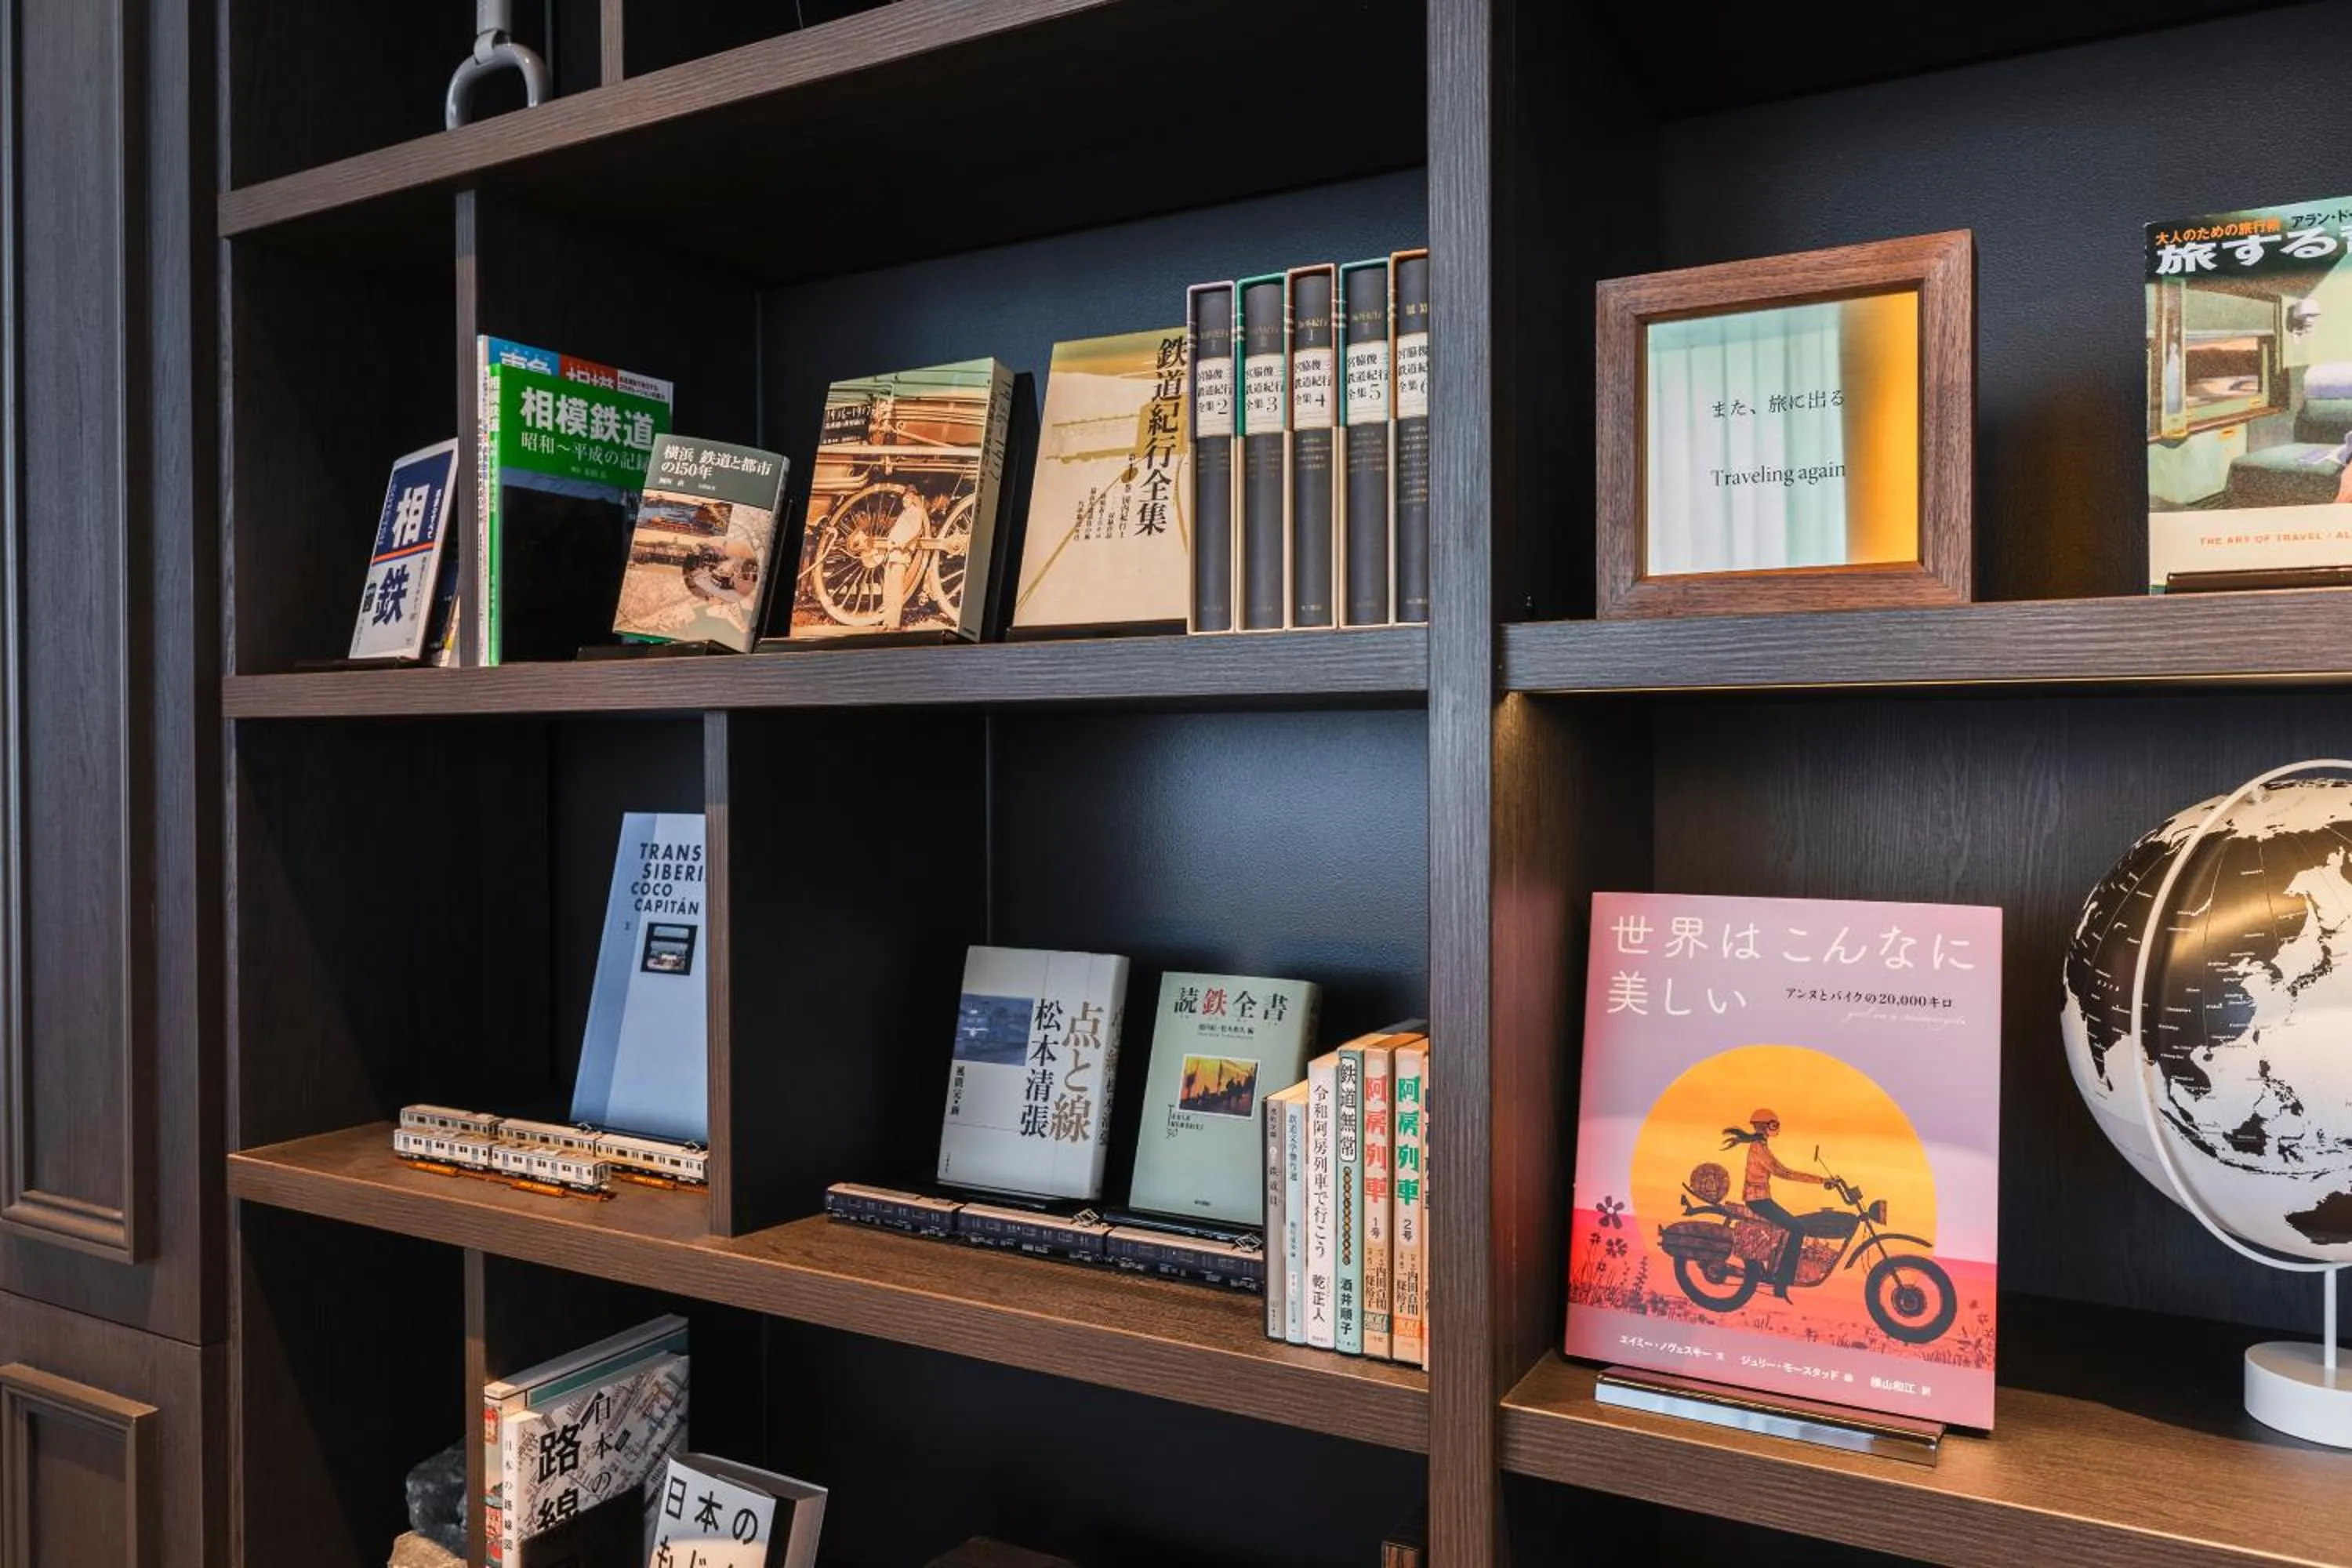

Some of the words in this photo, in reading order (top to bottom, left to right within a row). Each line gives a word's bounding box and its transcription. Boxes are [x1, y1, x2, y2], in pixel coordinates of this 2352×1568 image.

[521, 387, 654, 451] 相模鉄道
[1712, 390, 1845, 419] また、旅に出る
[1134, 337, 1188, 537] 鉄道紀行全集
[661, 463, 713, 479] の150年
[665, 444, 695, 462] 横浜
[699, 448, 772, 476] 鉄道と都市
[1710, 466, 1795, 488] Traveling
[1798, 463, 1846, 487] again
[372, 483, 430, 627] 相鉄
[639, 843, 702, 862] TRANS
[642, 862, 705, 883] SIBERI
[630, 881, 673, 898] COCO
[633, 897, 699, 916] CAPITÁN
[1611, 915, 1976, 970] 世界はこんなに
[1174, 986, 1288, 1022] 読鉄全書
[1606, 971, 1748, 1016] 美しい
[1785, 987, 1953, 1008] アンヌとバイクの20,000キロ
[1020, 998, 1064, 1138] 松本清張
[1050, 1001, 1104, 1142] 点と線
[1339, 1063, 1356, 1157] 鉄道無常
[1365, 1075, 1388, 1204] 阿房列車
[1396, 1075, 1421, 1206] 阿房列車
[1370, 1217, 1381, 1240] 1号
[1402, 1218, 1414, 1242] 2号
[1340, 1279, 1353, 1335] 酒井順子
[665, 1475, 758, 1545] 日本の
